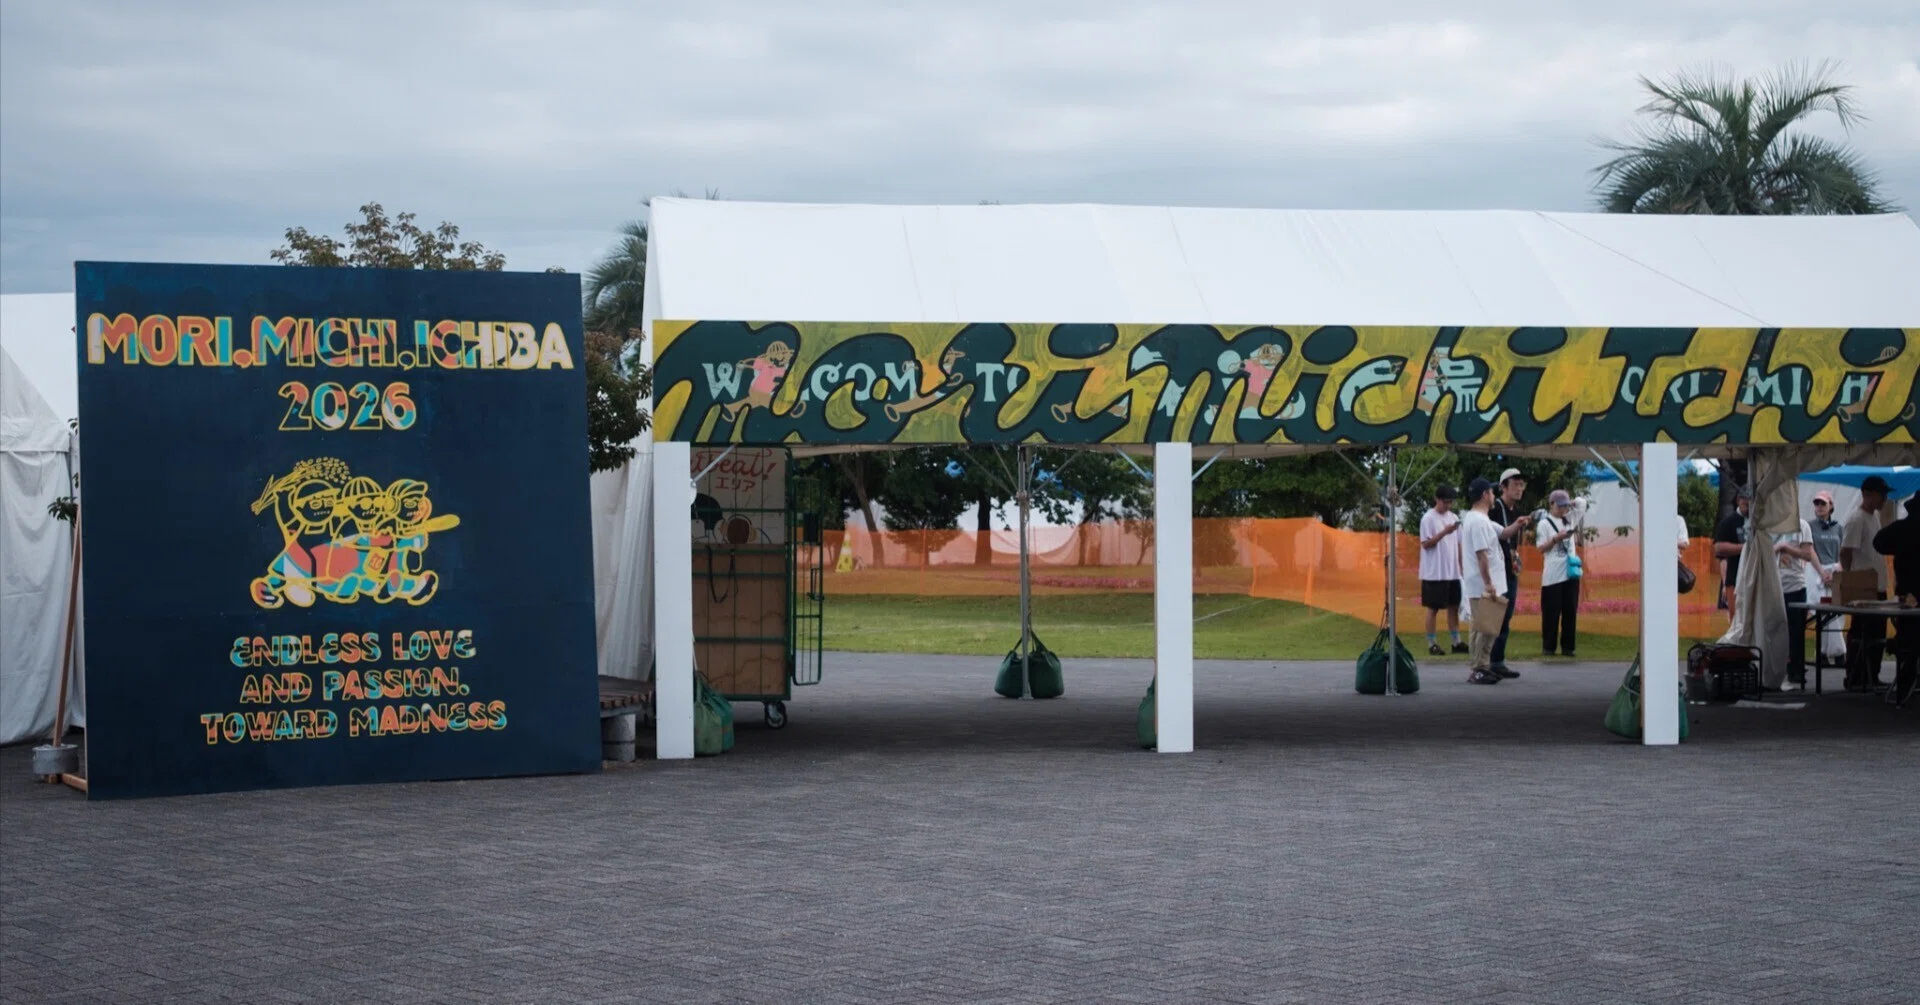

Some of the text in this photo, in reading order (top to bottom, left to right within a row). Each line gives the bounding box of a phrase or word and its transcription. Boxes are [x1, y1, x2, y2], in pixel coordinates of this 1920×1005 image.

[278, 381, 417, 431] 2026
[714, 476, 756, 493] エリア
[229, 629, 477, 668] ENDLESS LOVE
[239, 666, 470, 704] AND PASSION.
[200, 700, 508, 745] TOWARD MADNESS
